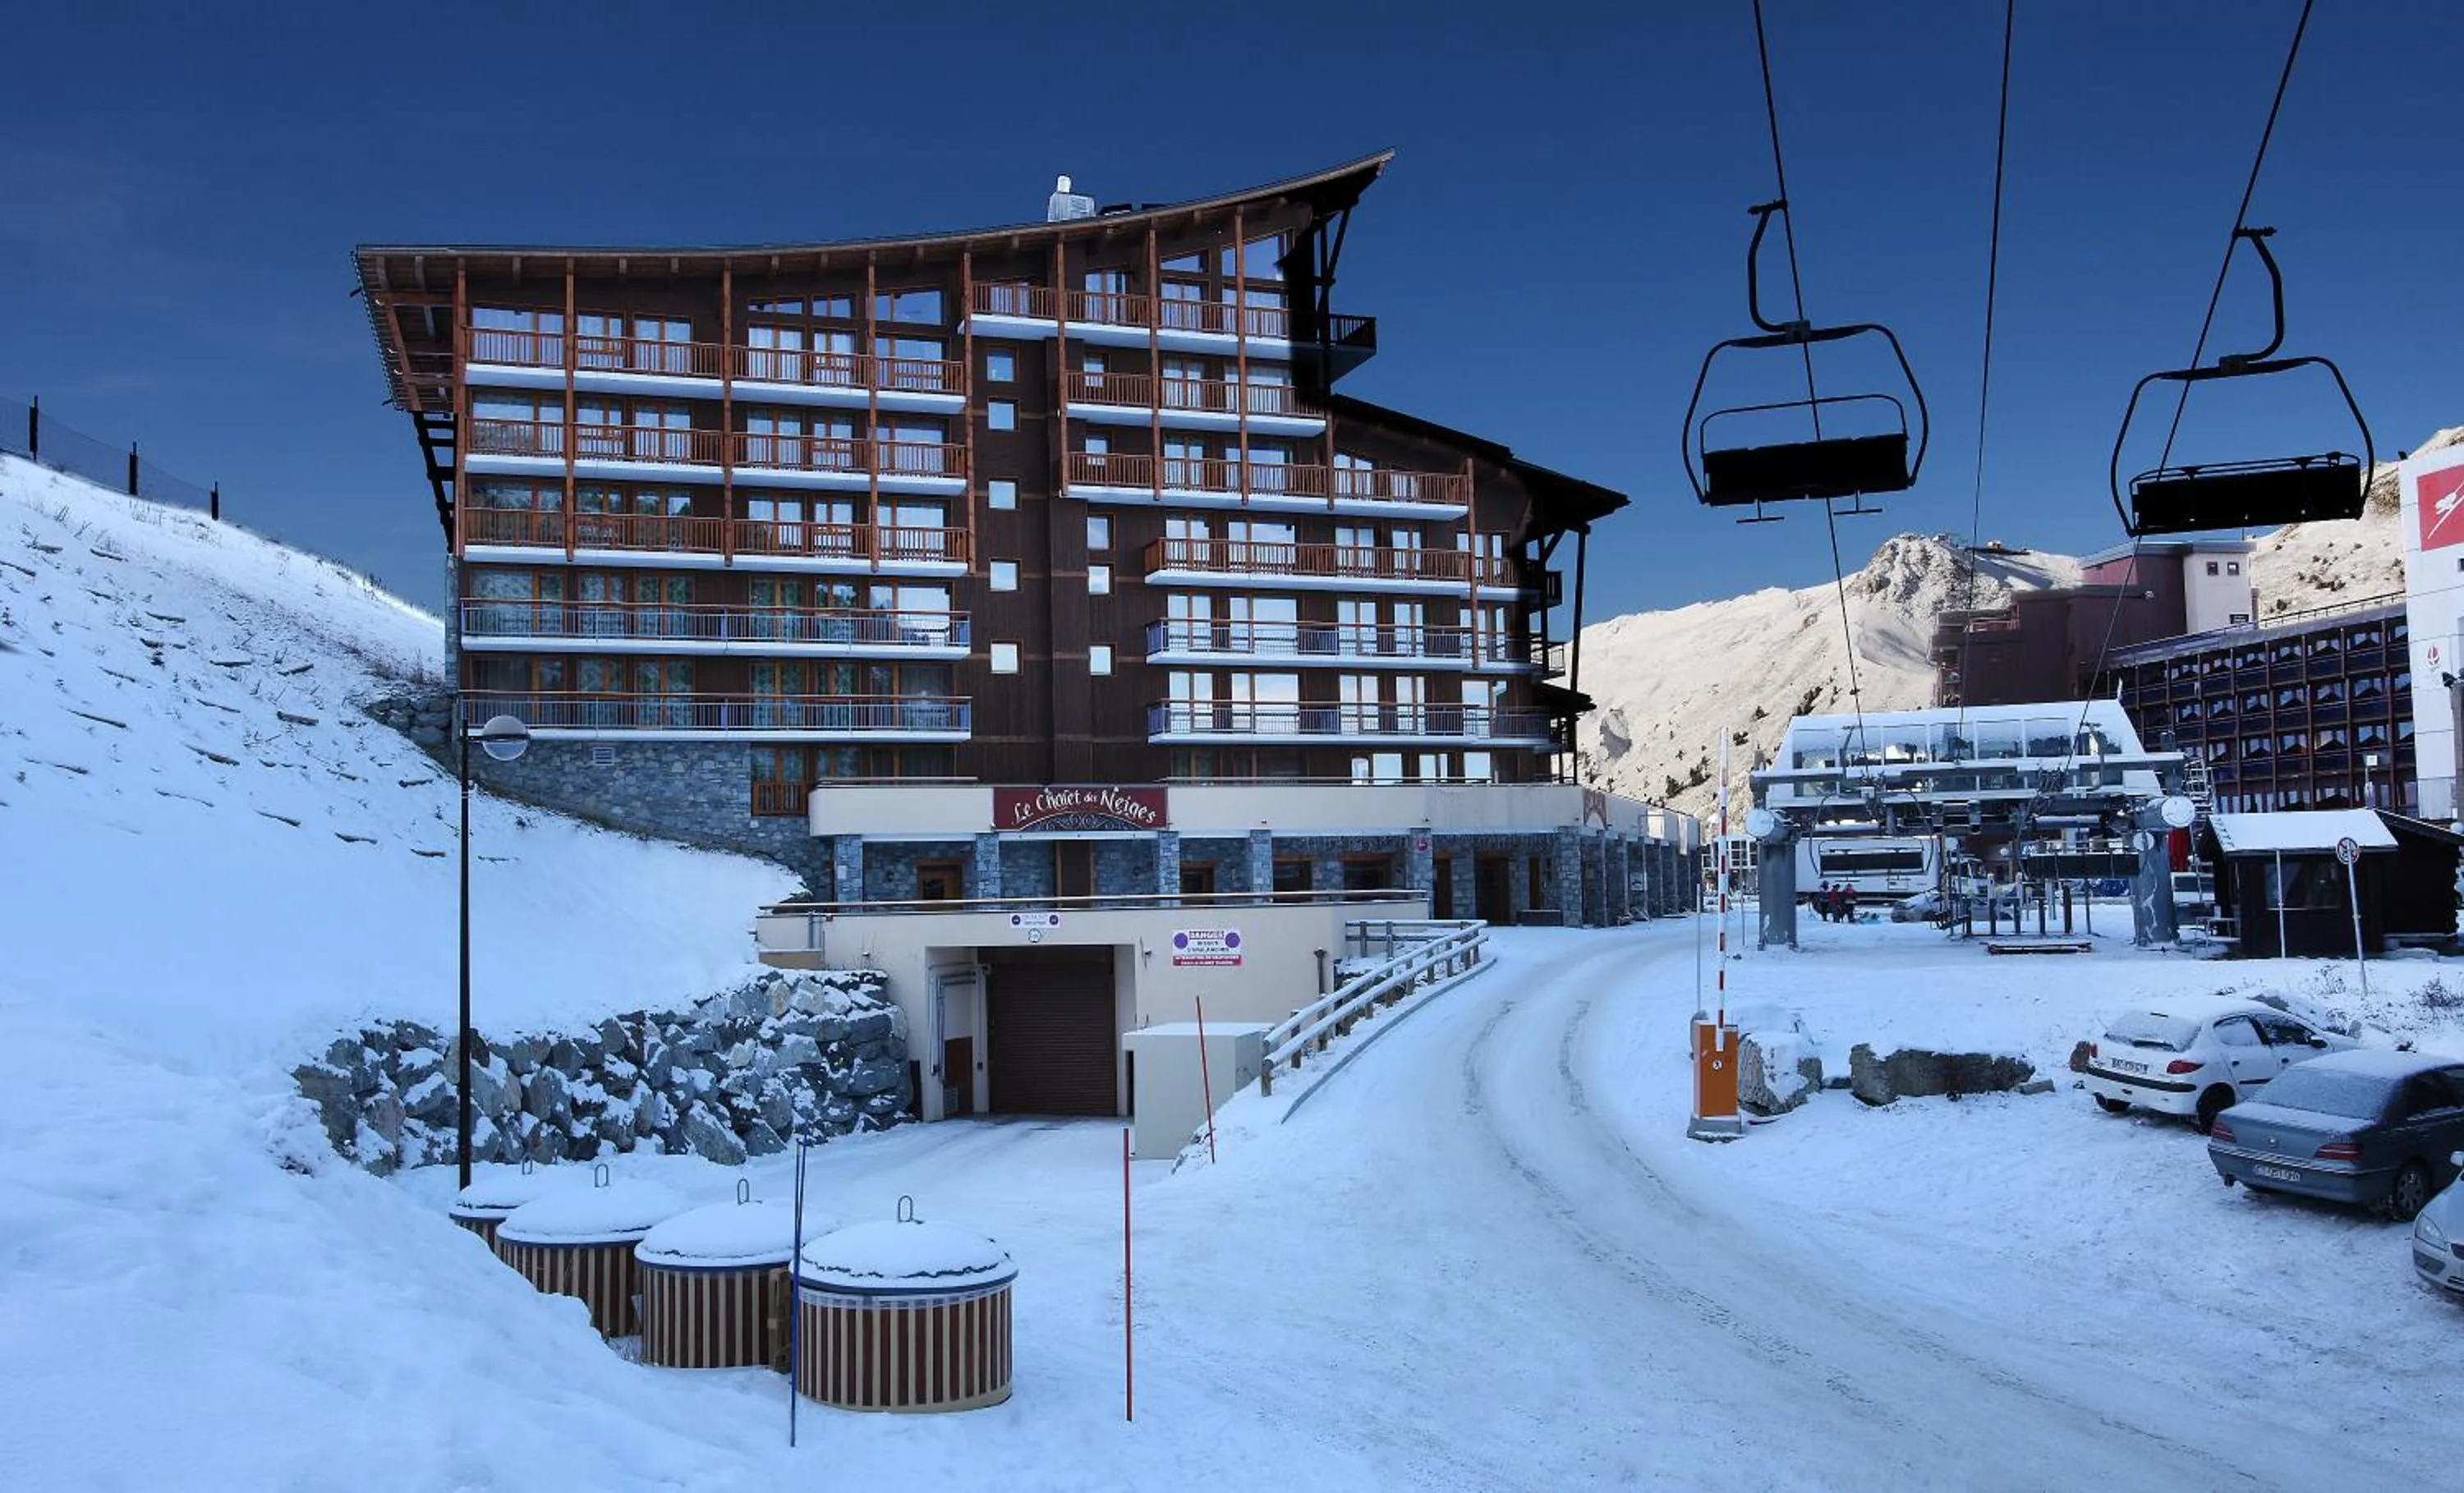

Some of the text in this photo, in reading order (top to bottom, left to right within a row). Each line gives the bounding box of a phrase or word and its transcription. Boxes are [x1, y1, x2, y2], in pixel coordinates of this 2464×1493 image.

[1011, 802, 1034, 826] Le
[1036, 788, 1082, 812] Chalet
[1100, 786, 1157, 824] Neiges
